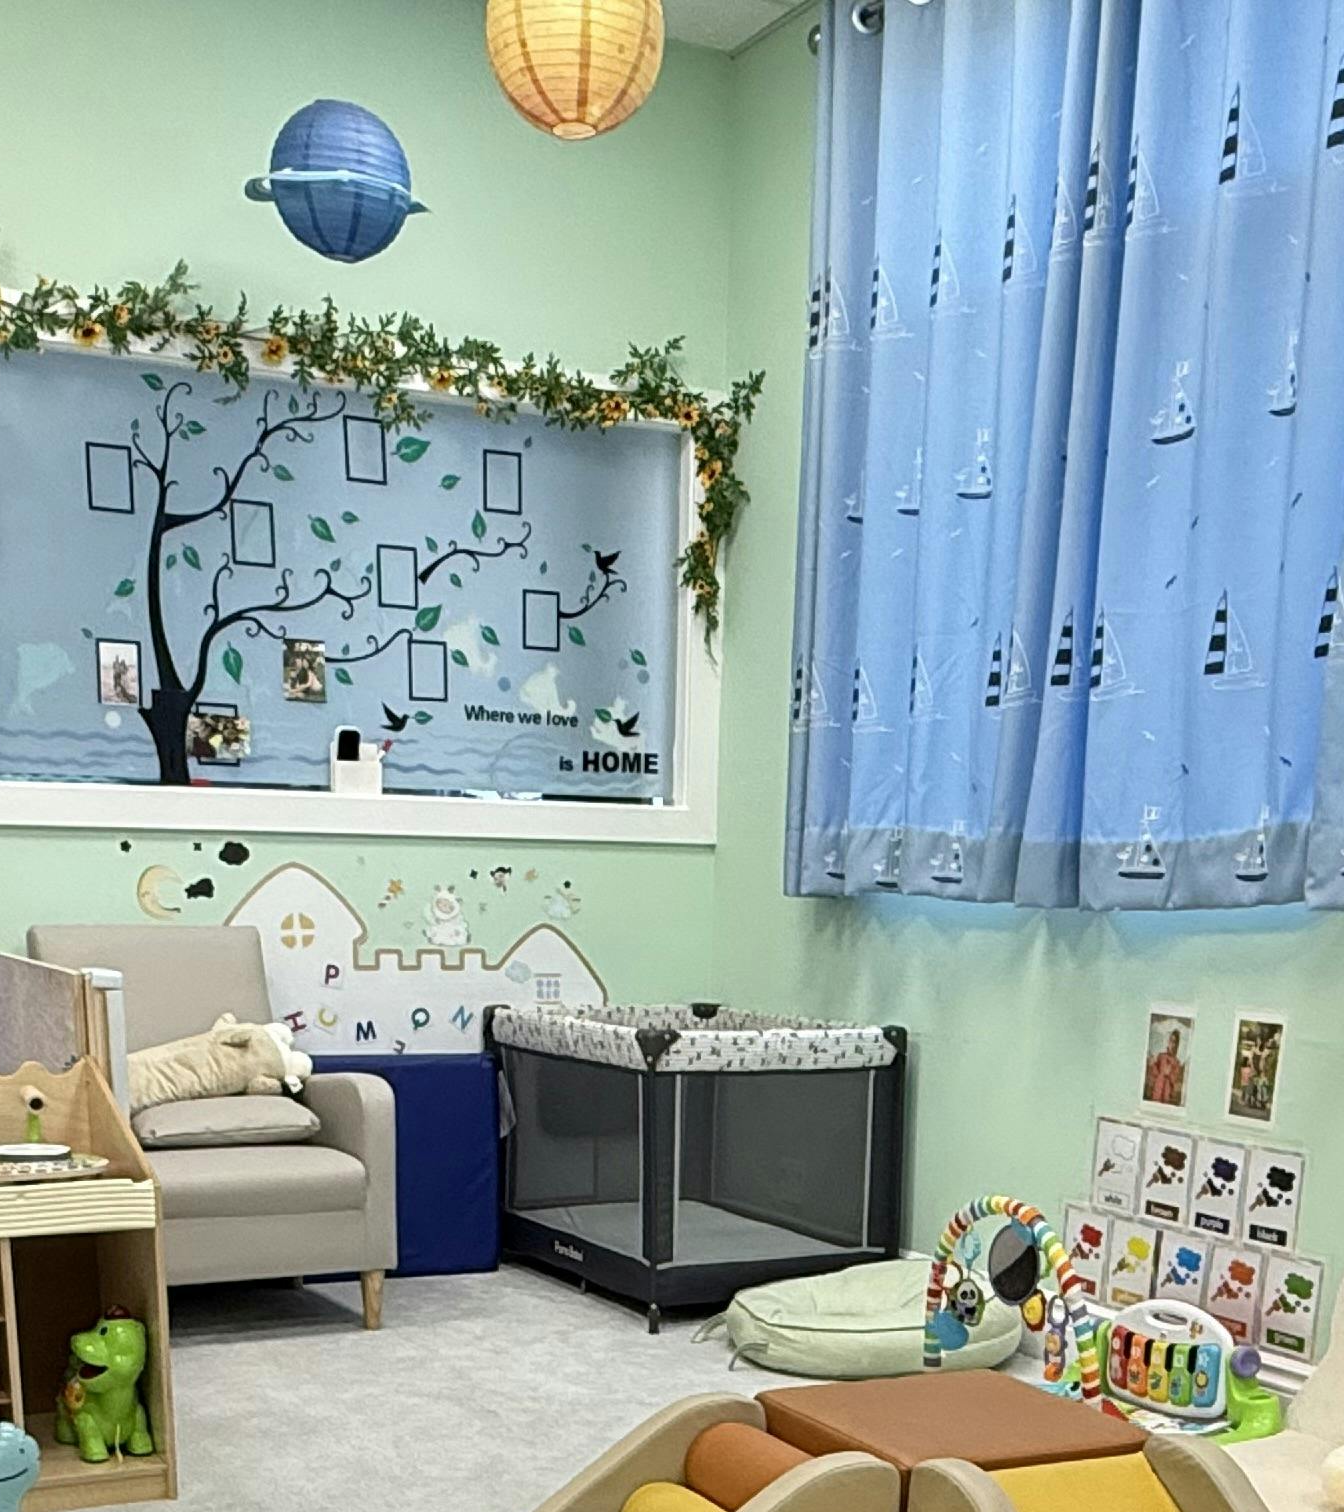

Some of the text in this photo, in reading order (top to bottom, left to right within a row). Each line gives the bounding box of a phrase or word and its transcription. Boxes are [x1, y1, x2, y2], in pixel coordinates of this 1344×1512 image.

[464, 704, 579, 728] Where we love
[559, 750, 660, 775] is HOME
[324, 964, 340, 985] P
[356, 1020, 377, 1042] M
[411, 1007, 430, 1031] Q
